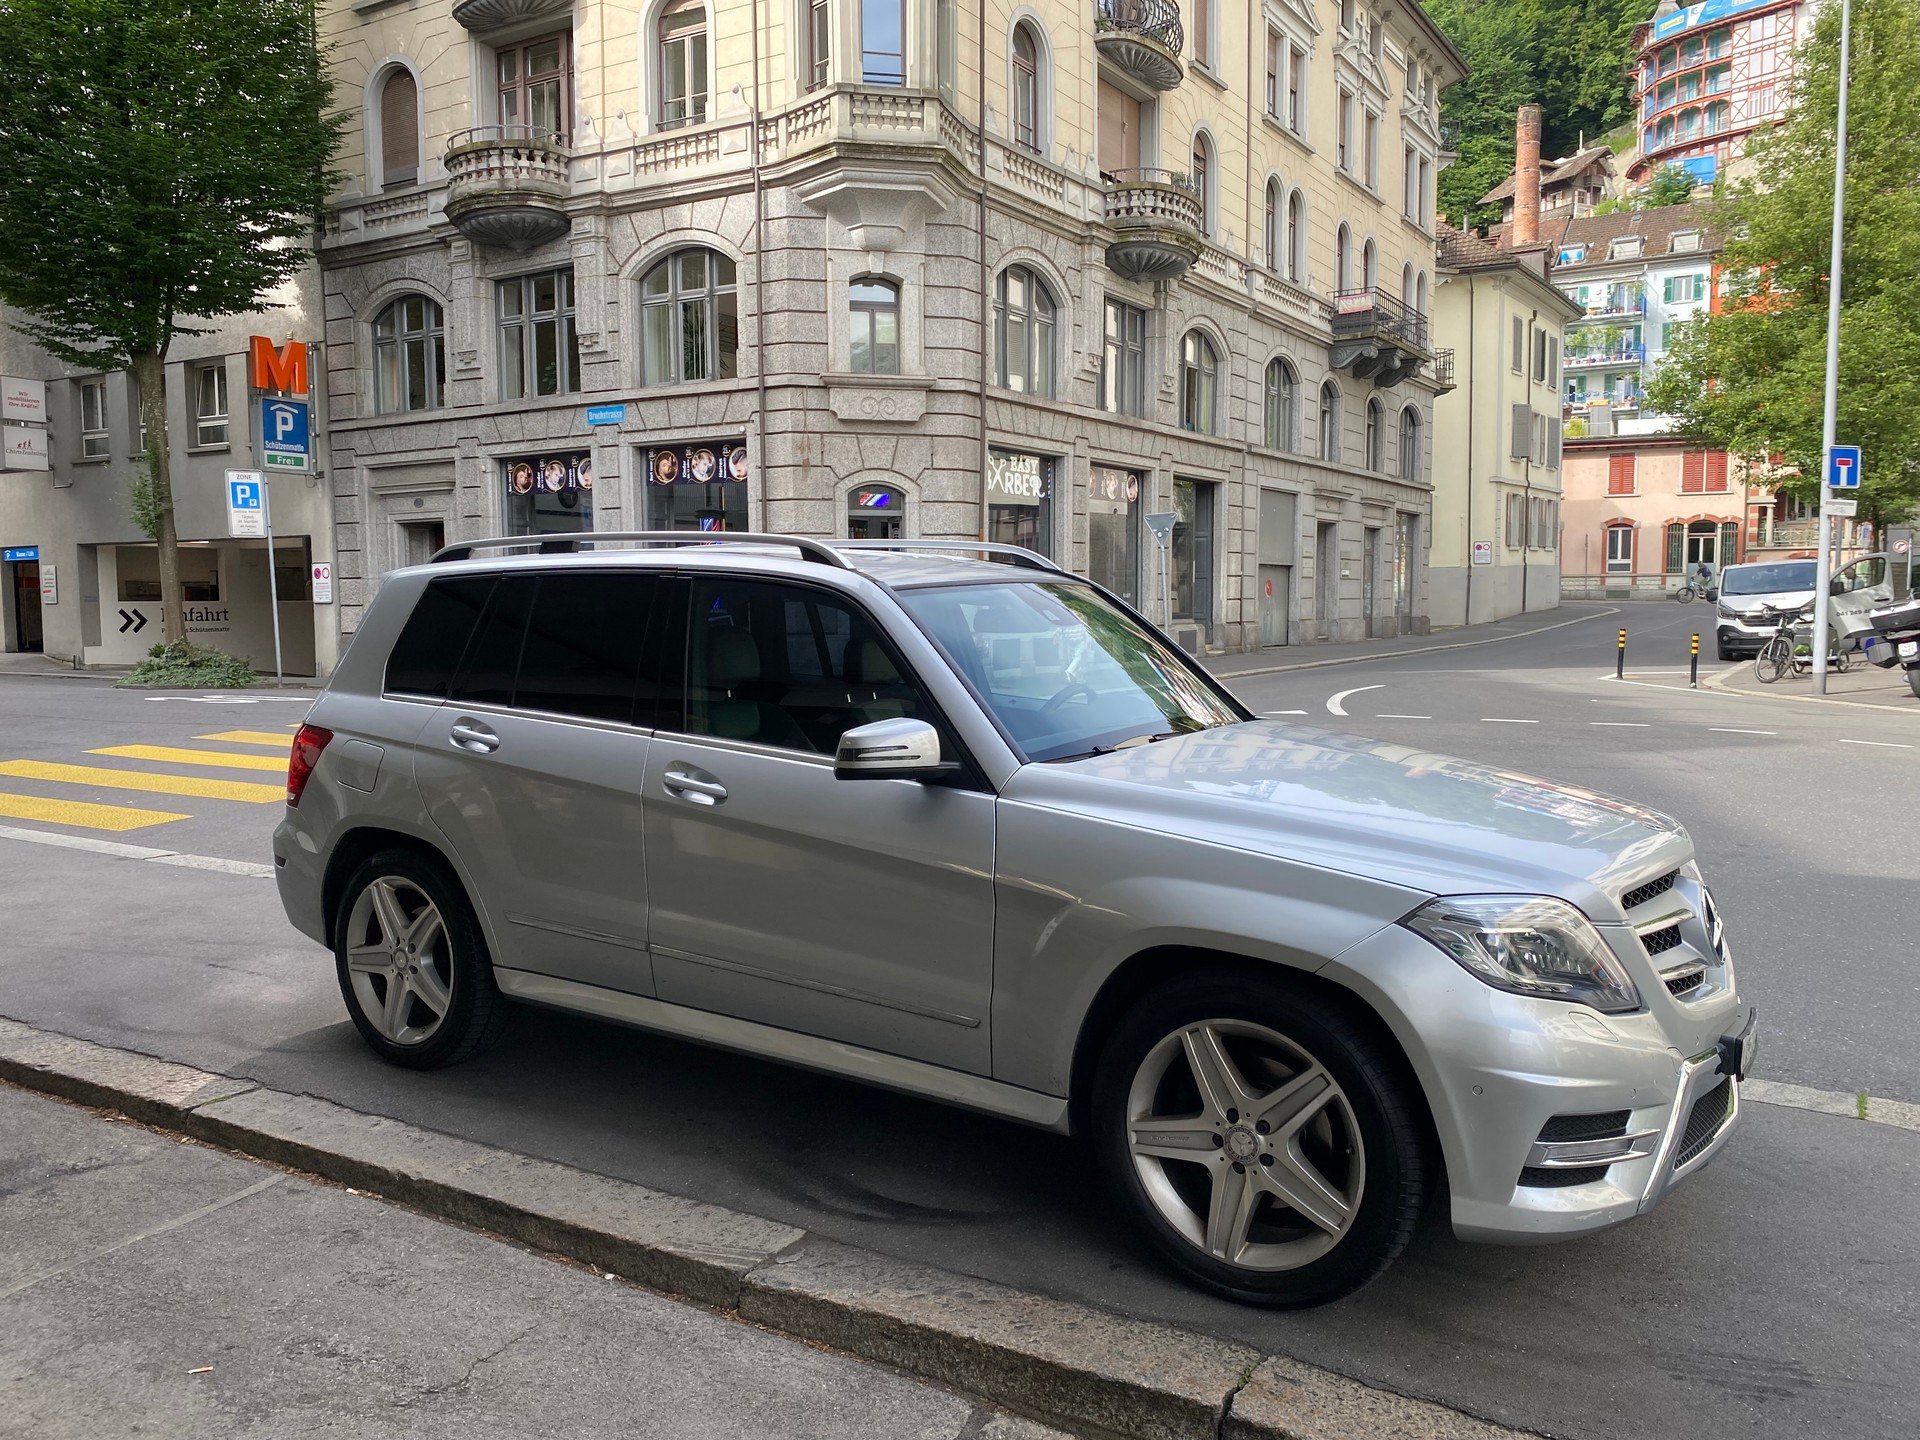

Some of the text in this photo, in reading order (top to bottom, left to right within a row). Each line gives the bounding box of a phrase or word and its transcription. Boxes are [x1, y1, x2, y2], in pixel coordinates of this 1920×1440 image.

[249, 335, 308, 395] M
[588, 410, 623, 421] Bruchstrasse
[276, 410, 294, 441] P
[264, 440, 305, 452] Schützenmatte
[277, 456, 295, 466] Frei
[1010, 454, 1039, 474] EASY
[236, 484, 251, 505] P
[160, 607, 229, 622] nfahrt
